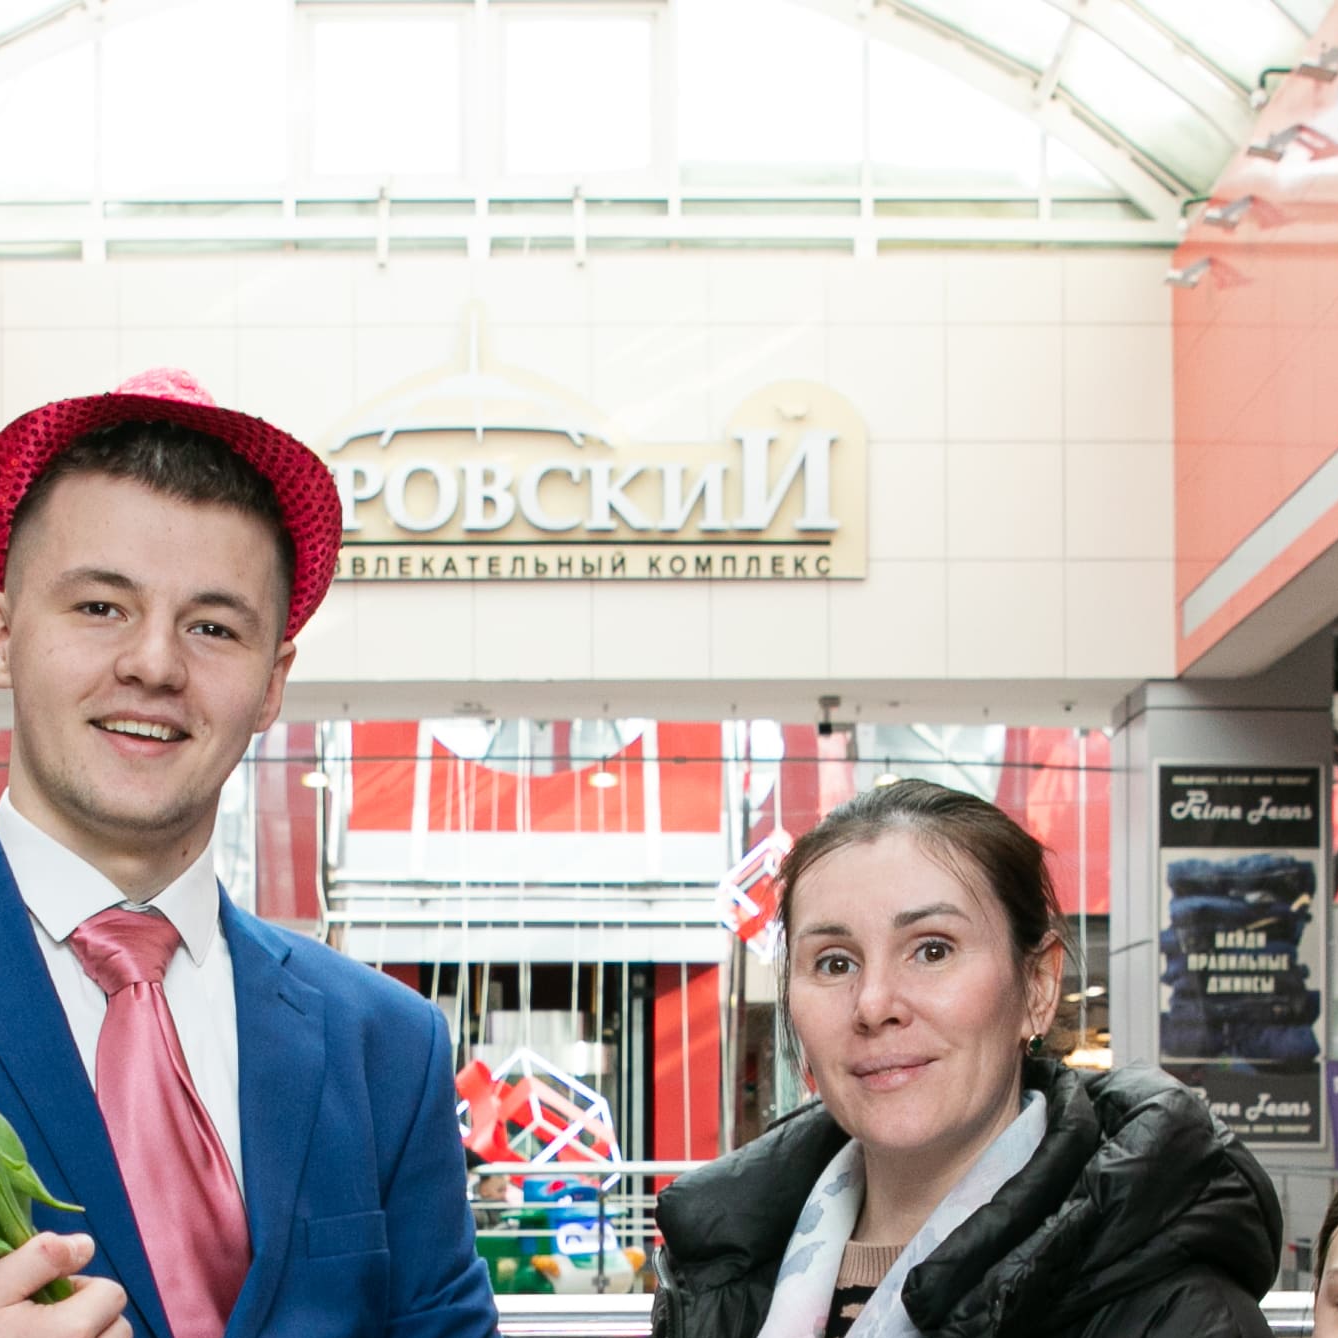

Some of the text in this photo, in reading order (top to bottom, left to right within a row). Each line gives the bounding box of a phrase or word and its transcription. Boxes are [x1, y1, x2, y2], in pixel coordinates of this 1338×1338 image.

[648, 555, 831, 576] КОМПЛЕКС
[1170, 790, 1313, 825] Prime Jeans
[1214, 929, 1266, 949] НАЙДИ
[1187, 953, 1289, 971] ПРАВИЛЬНЫЕ
[1206, 976, 1275, 993] ДЖИНСЫ
[1245, 1092, 1312, 1122] Jeans
